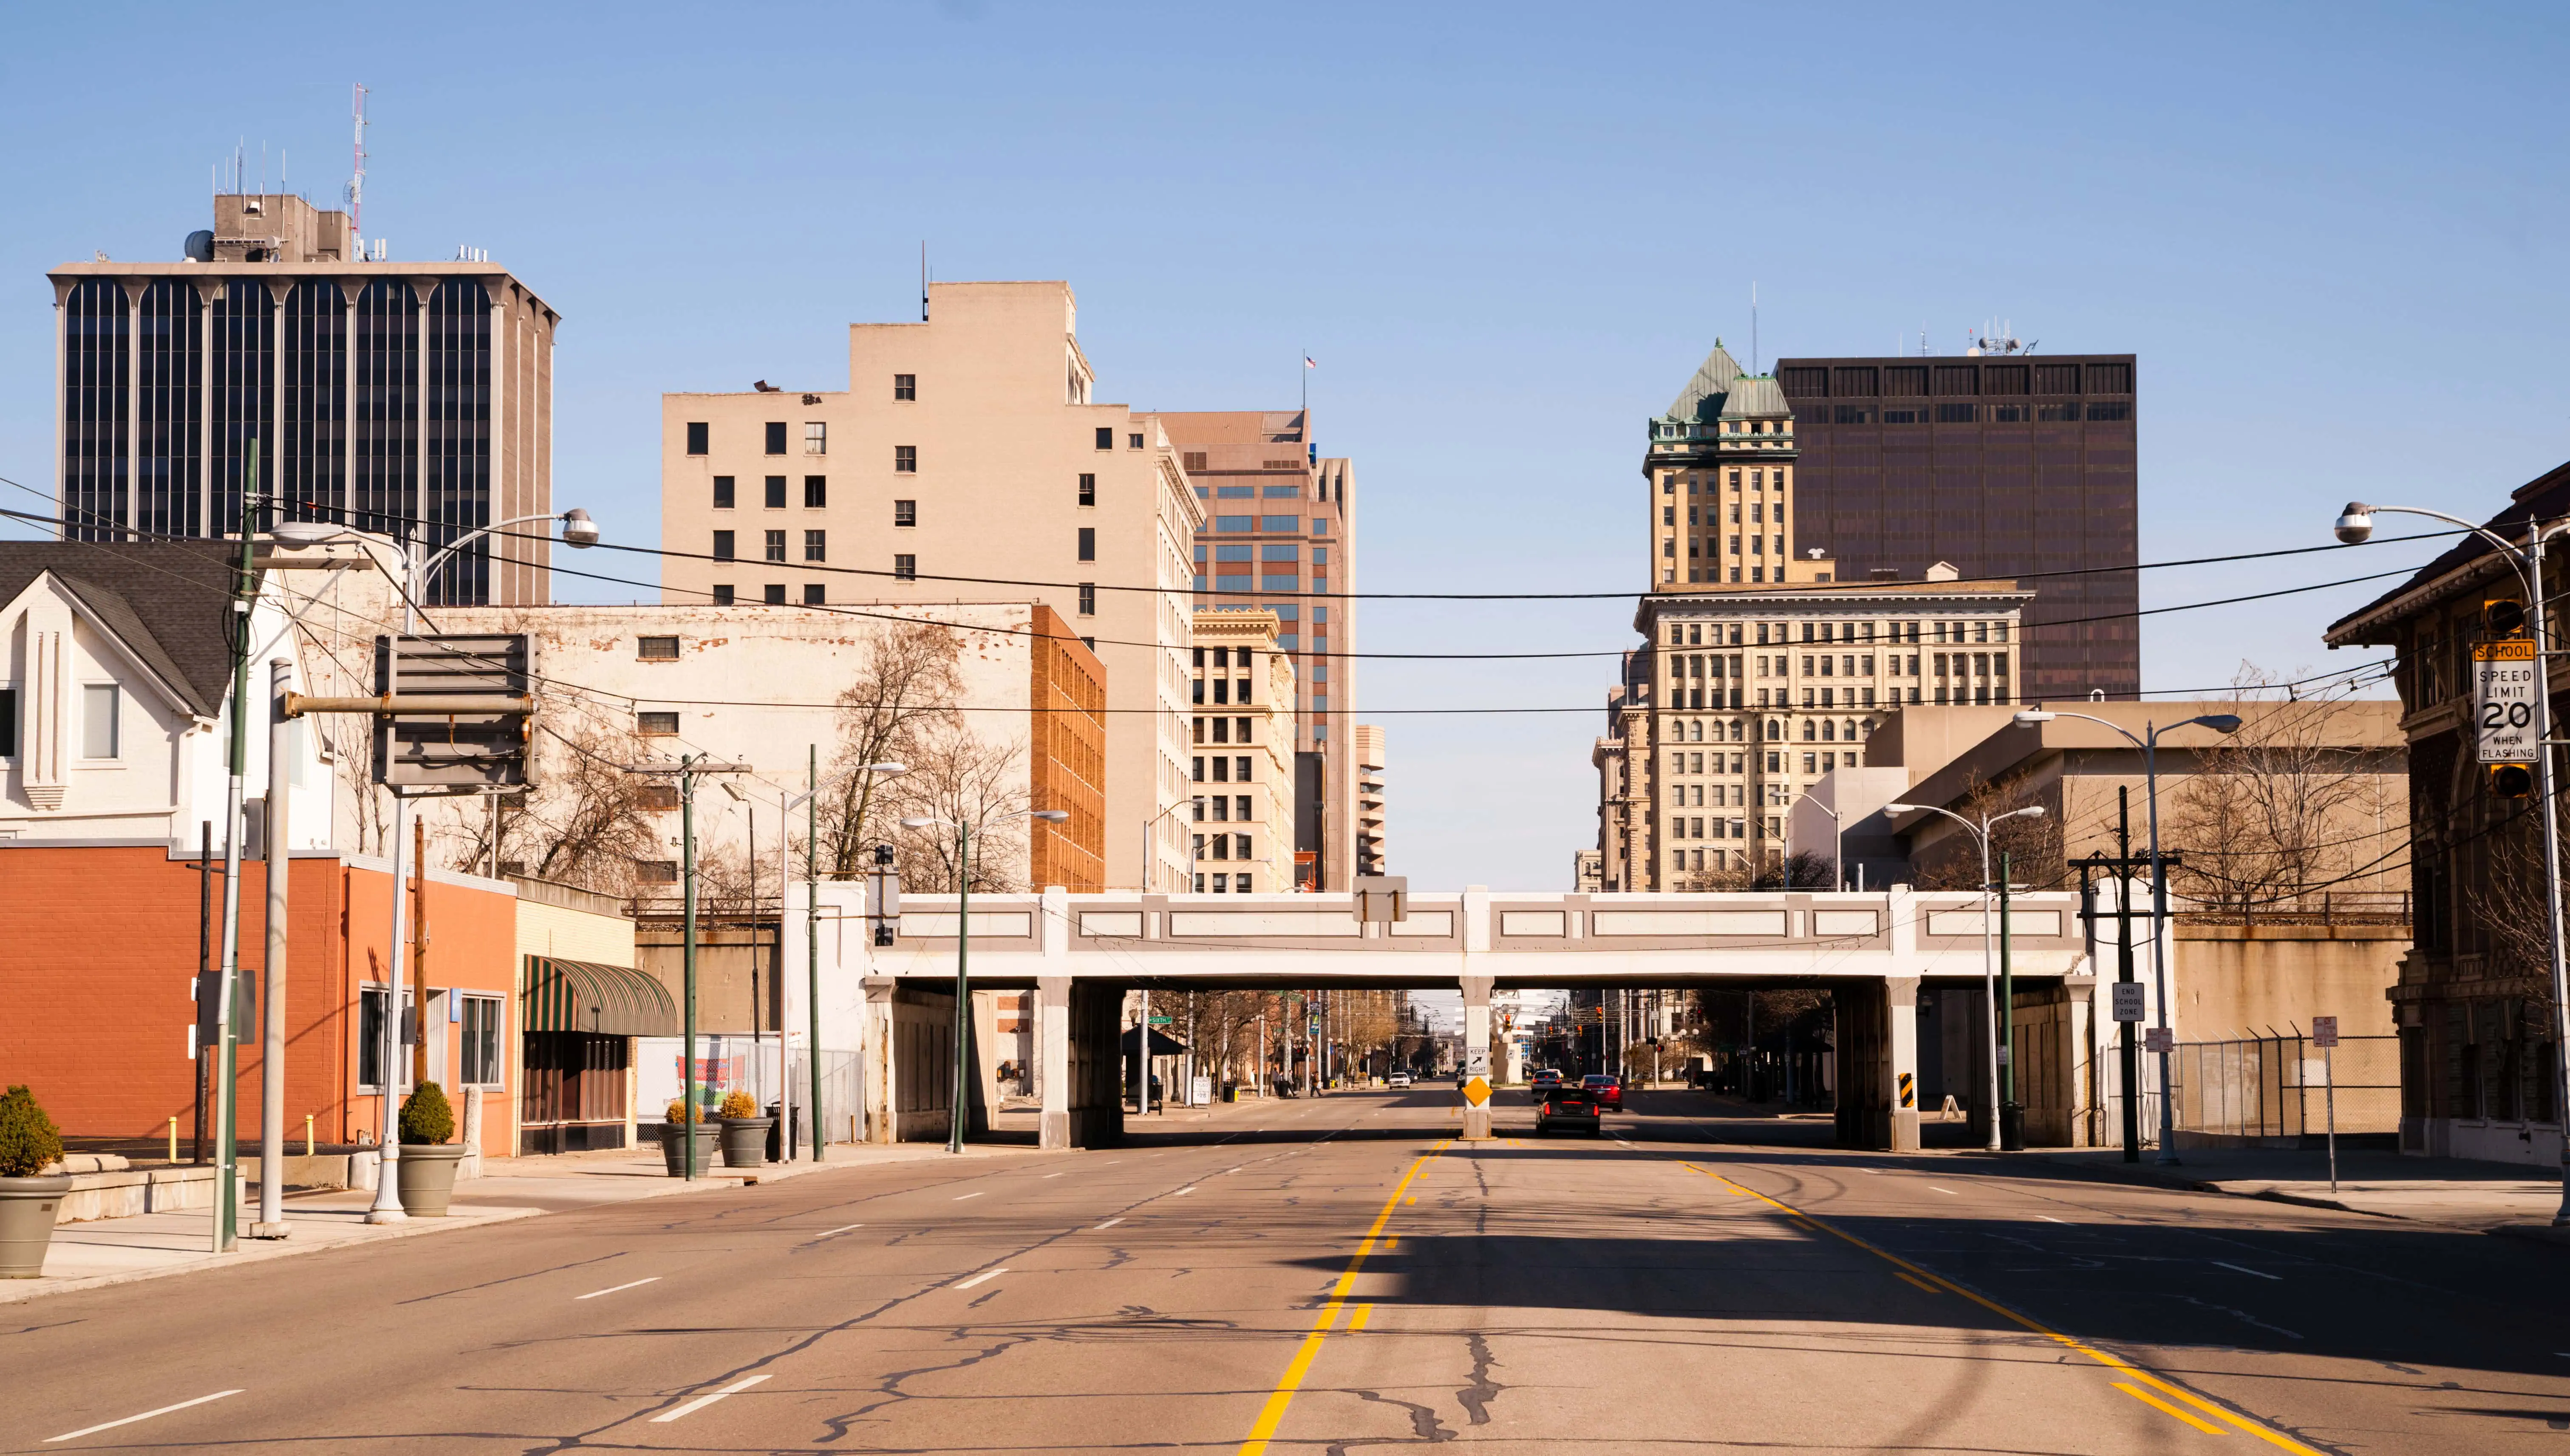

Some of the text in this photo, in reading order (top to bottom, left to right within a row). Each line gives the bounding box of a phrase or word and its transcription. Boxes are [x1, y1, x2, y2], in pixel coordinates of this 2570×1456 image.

[2477, 645, 2532, 657] SCHOOL
[2479, 670, 2531, 682] SPEED
[2486, 687, 2525, 698] LIMIT
[2482, 702, 2531, 729] 20
[2493, 736, 2522, 745] WHEN
[2482, 749, 2534, 758] FLASHING
